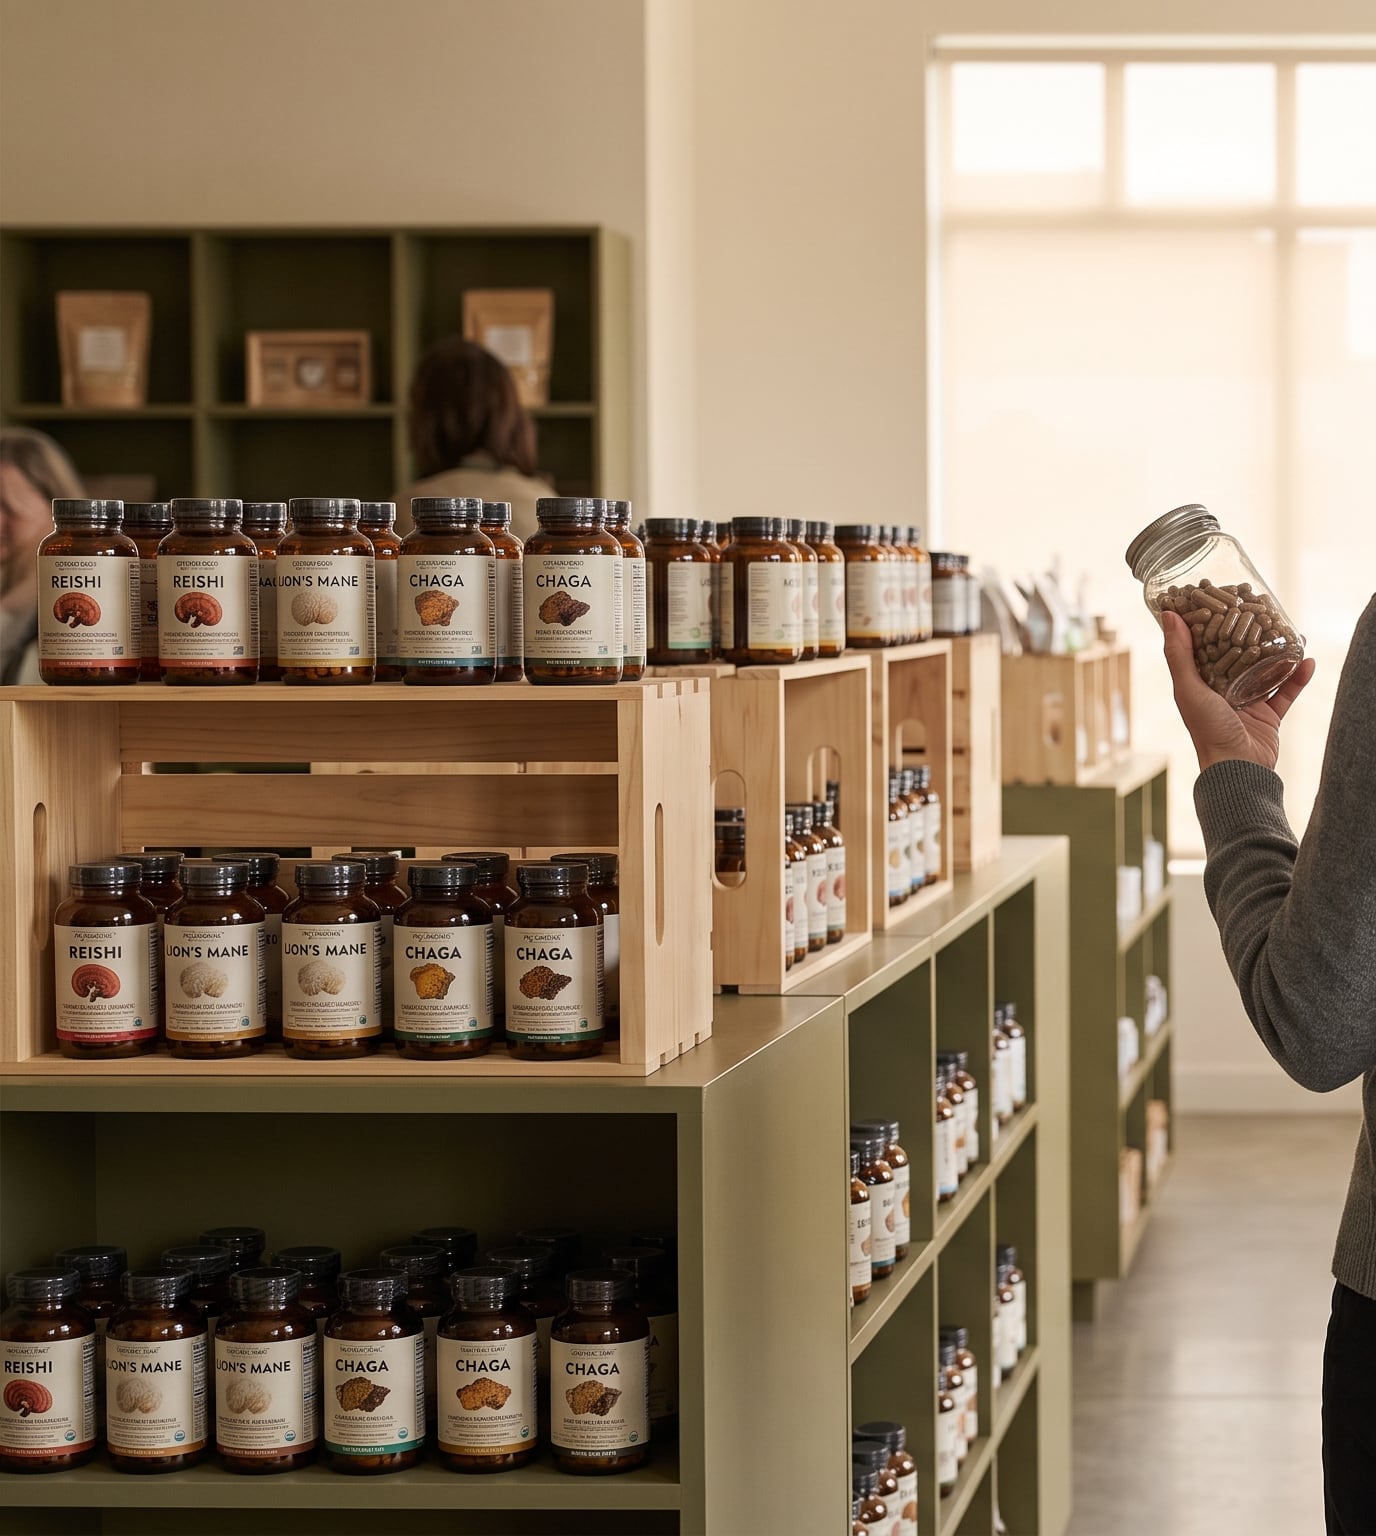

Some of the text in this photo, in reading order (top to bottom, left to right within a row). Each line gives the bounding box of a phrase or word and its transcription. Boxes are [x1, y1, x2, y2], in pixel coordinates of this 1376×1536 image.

[51, 575, 101, 589] REISHI
[173, 575, 224, 589] REISHI
[317, 575, 359, 587] MANE
[409, 574, 464, 588] CHAGA
[536, 574, 592, 588] CHAGA
[69, 945, 122, 959] REISHI
[207, 944, 249, 958] MANE
[325, 942, 367, 956] MANE
[405, 945, 462, 960] CHAGA
[516, 947, 573, 961] CHAGA
[4, 1360, 53, 1374] REISHI
[140, 1360, 182, 1373] MANE
[250, 1360, 291, 1374] MANE
[335, 1358, 389, 1373] CHAGA
[455, 1358, 511, 1373] CHAGA
[565, 1361, 620, 1376] CHAGA
